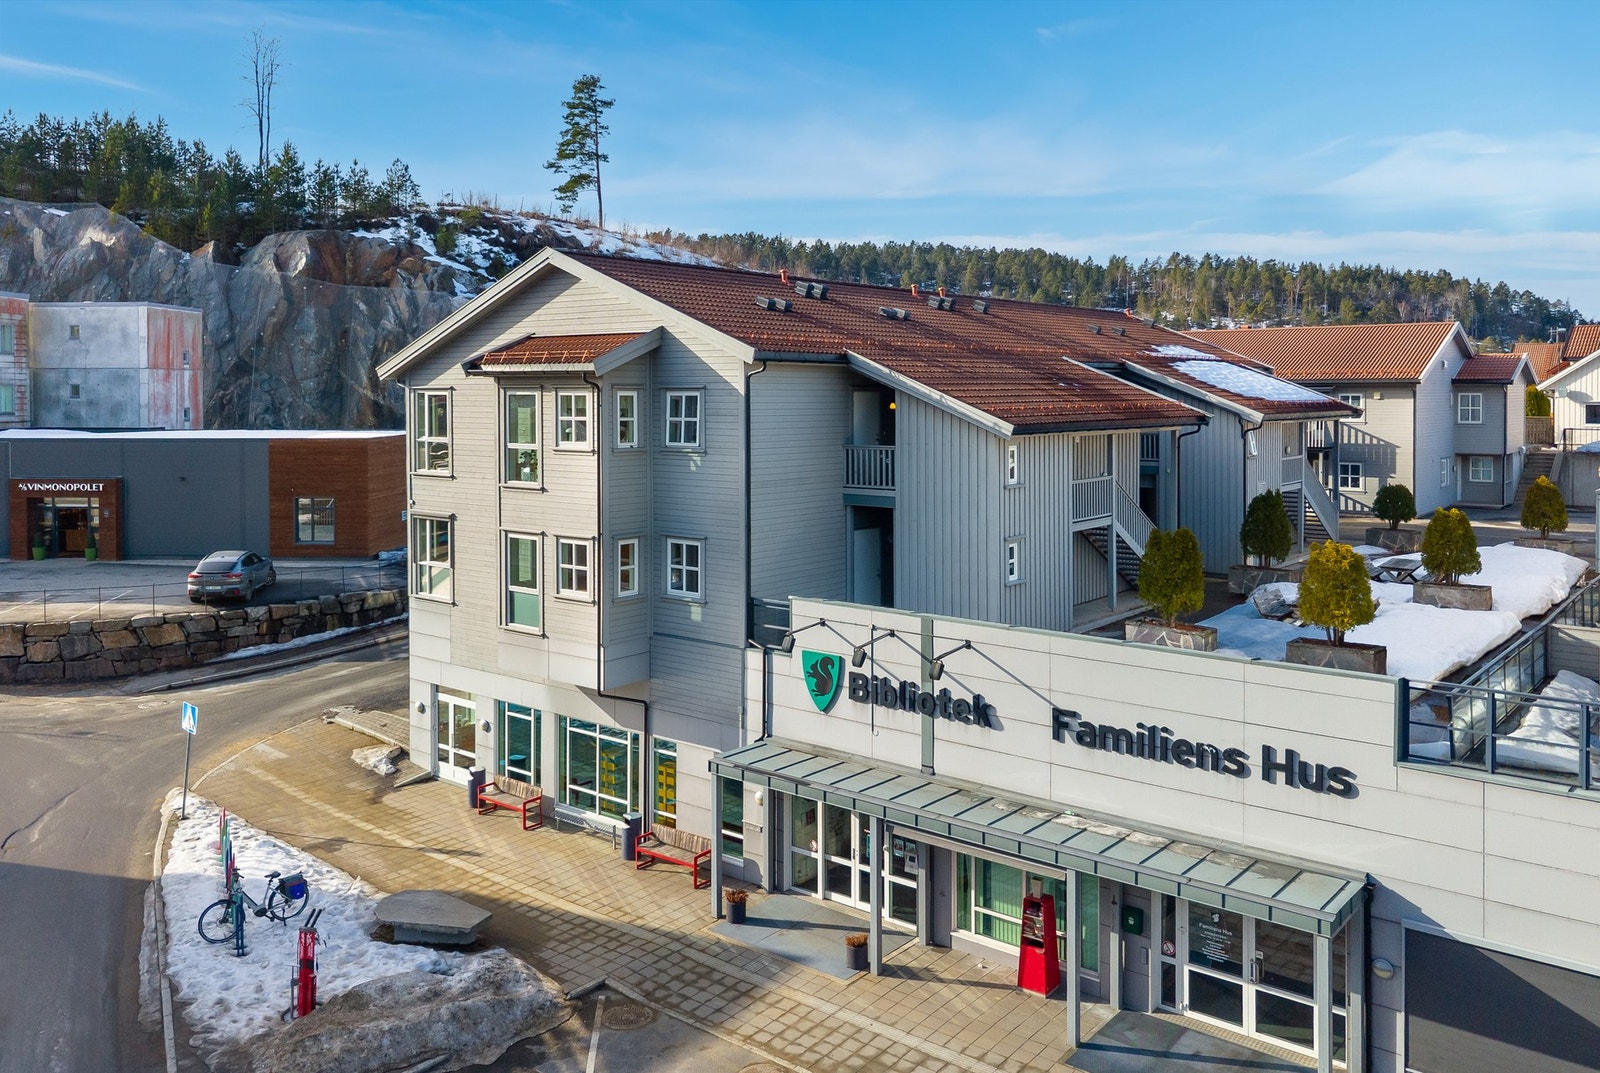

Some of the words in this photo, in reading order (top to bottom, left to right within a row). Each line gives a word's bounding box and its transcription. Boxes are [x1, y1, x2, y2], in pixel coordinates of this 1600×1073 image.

[27, 483, 104, 491] VINMONOPOLET
[848, 671, 996, 730] Bibliotek
[1052, 707, 1250, 778] Familiens
[1262, 744, 1359, 799] Hus
